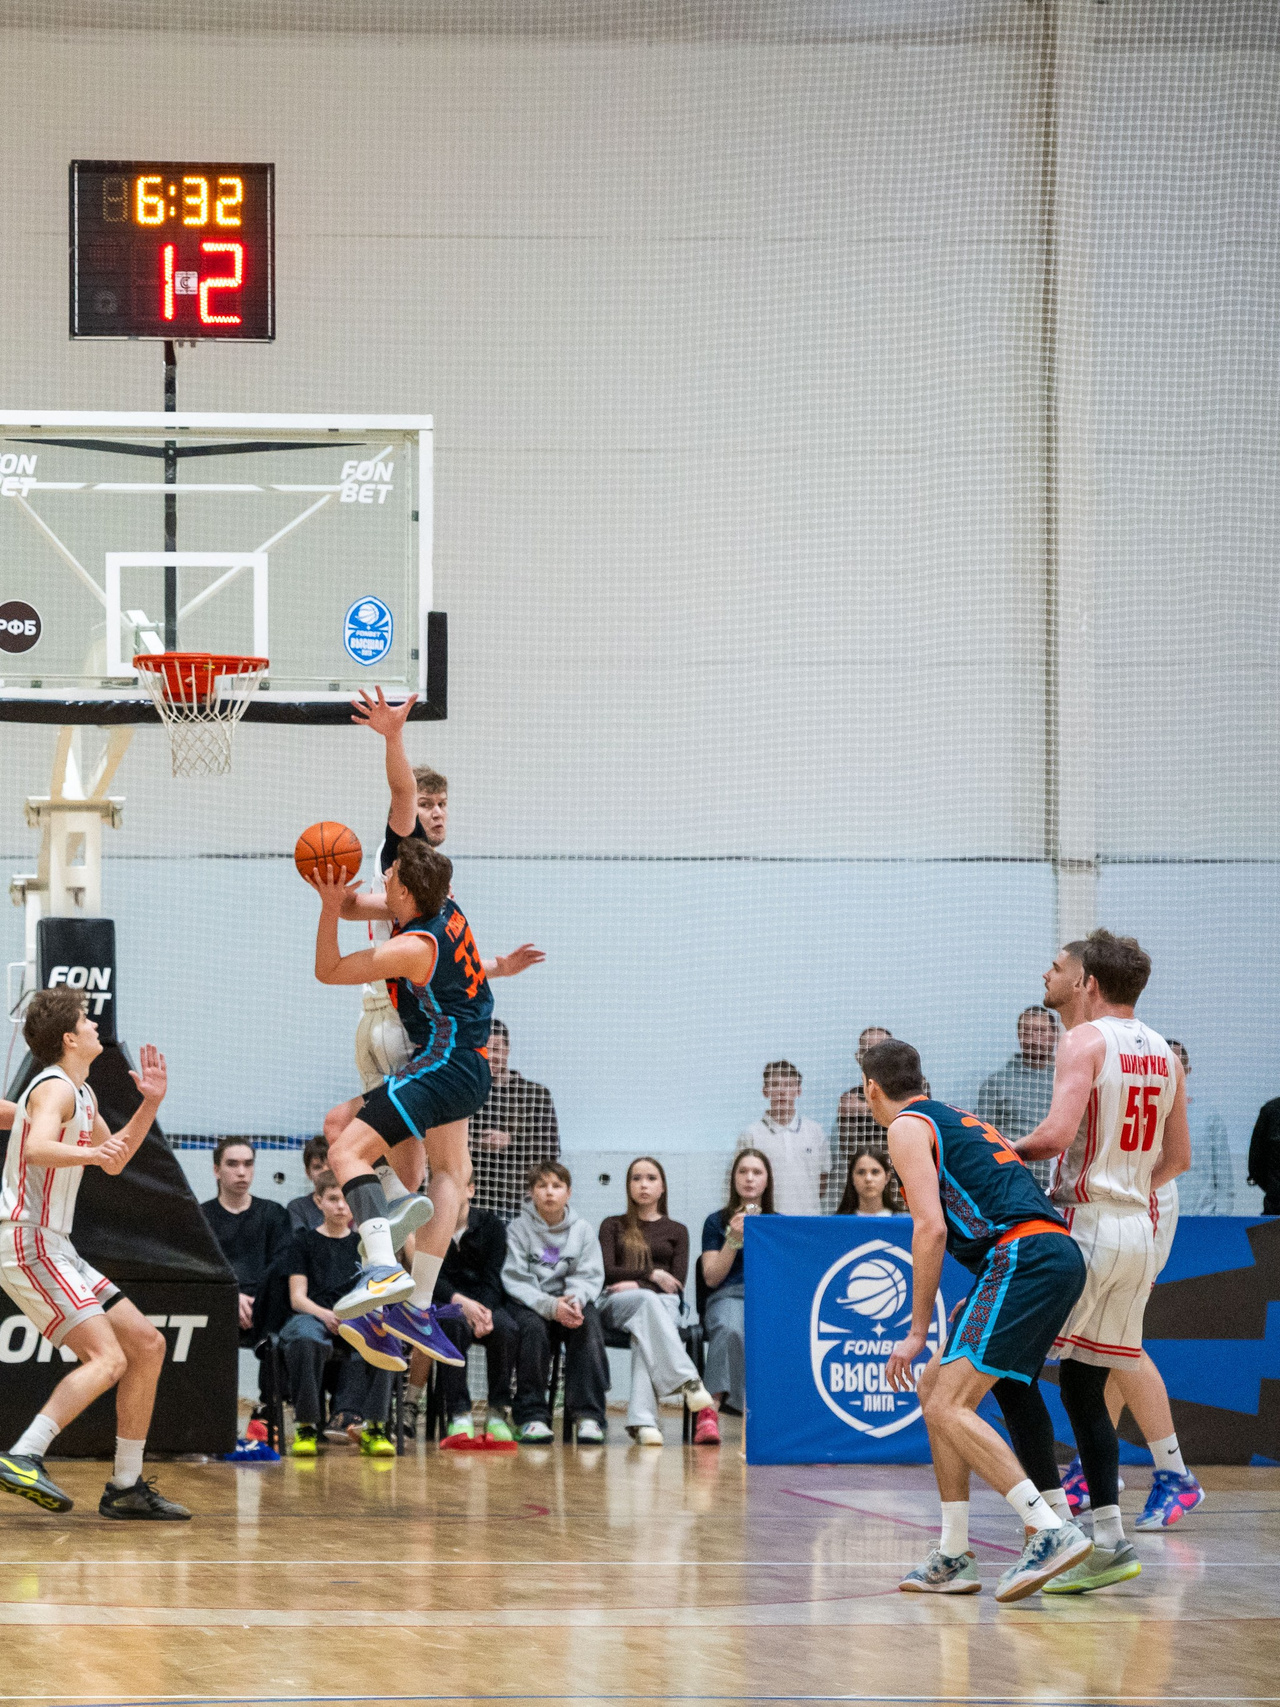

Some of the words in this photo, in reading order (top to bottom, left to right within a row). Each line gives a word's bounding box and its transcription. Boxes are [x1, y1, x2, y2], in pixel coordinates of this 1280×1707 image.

[136, 176, 242, 226] 6:32
[163, 241, 243, 324] 12
[340, 460, 394, 482] FON
[340, 482, 394, 504] BET
[47, 965, 112, 990] FON
[1120, 1085, 1162, 1152] 55
[843, 1340, 901, 1356] FONB
[863, 1394, 895, 1412] ЛИГА
